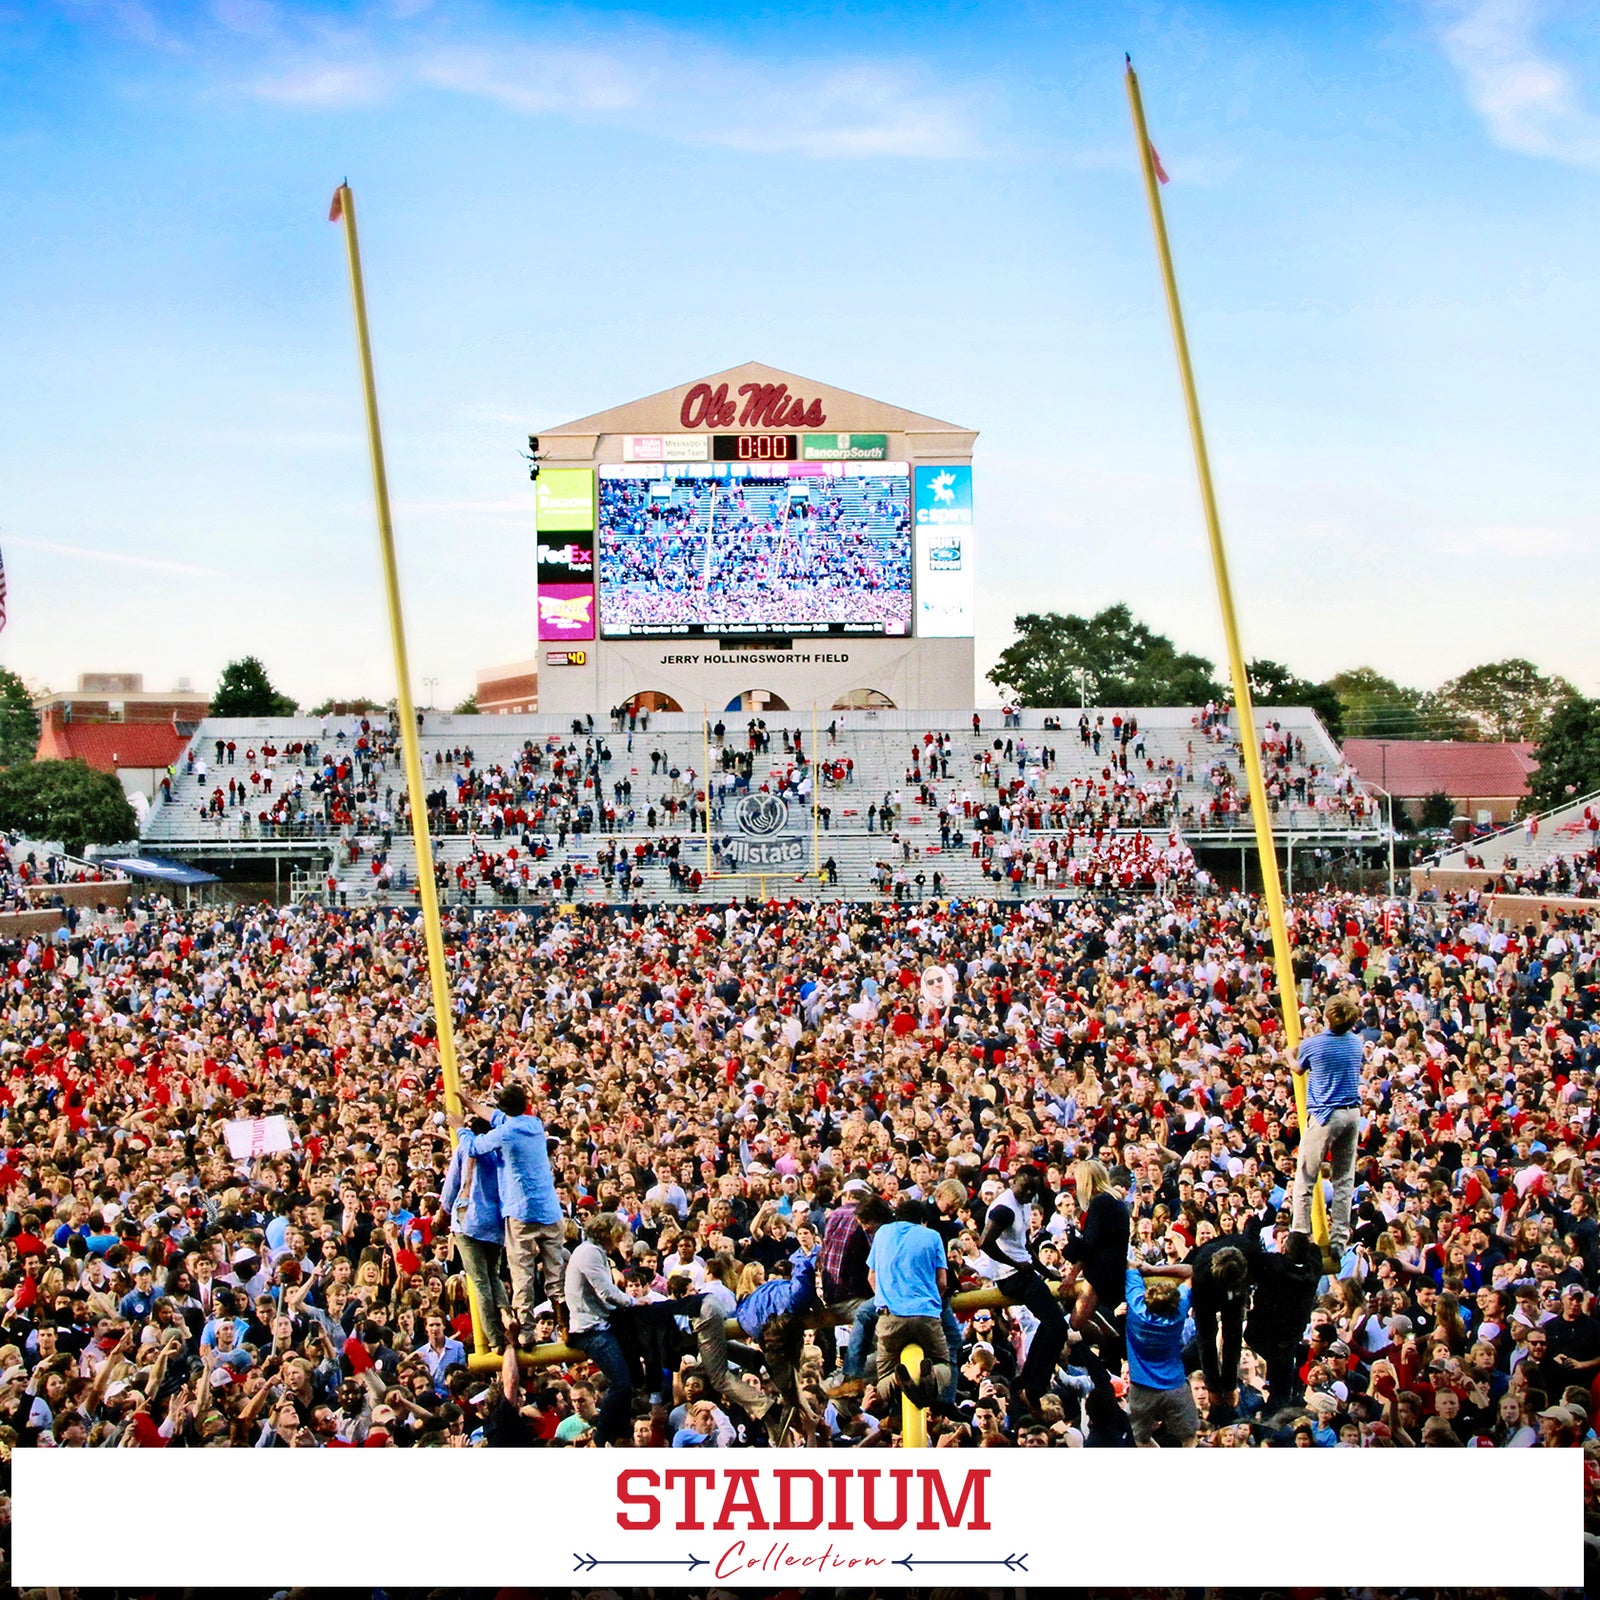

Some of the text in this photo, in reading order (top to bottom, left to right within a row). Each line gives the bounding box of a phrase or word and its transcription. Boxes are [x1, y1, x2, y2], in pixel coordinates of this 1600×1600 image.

[680, 383, 827, 428] Ole Miss
[738, 436, 787, 459] 0:00
[804, 447, 883, 459] BancorpSouth
[537, 544, 592, 564] FedEx
[544, 603, 587, 614] SONIC
[568, 651, 585, 665] 40
[661, 654, 849, 664] JERRY HOLLINGSWORTH FIELD
[722, 841, 803, 864] Allstate
